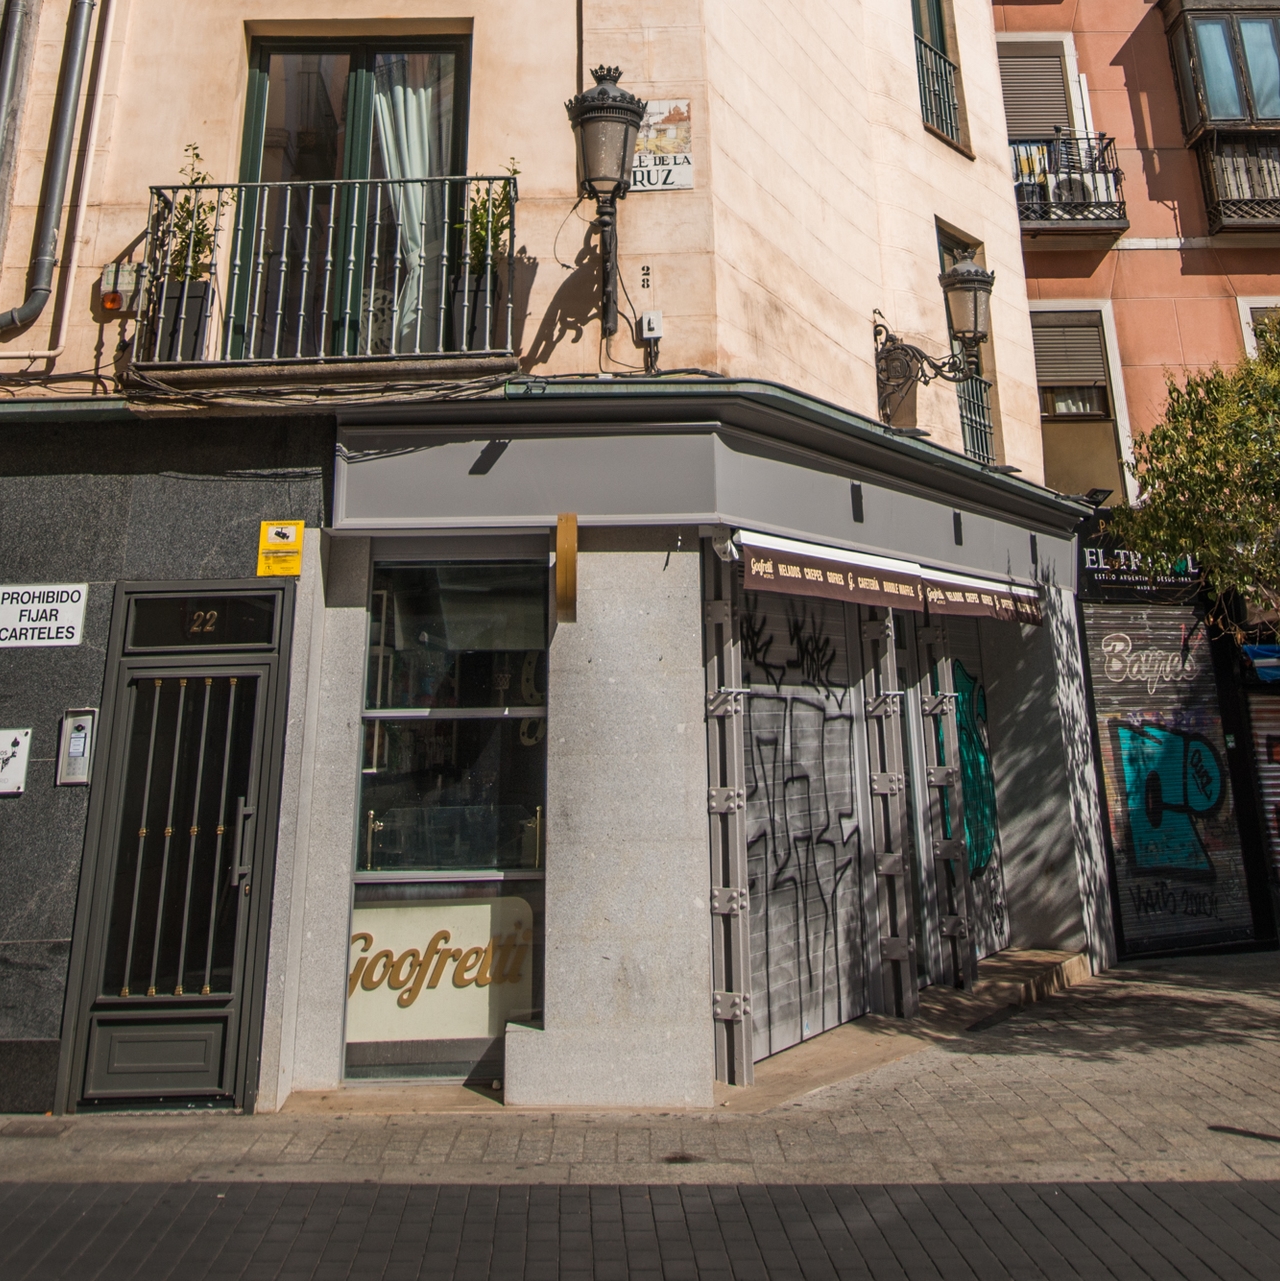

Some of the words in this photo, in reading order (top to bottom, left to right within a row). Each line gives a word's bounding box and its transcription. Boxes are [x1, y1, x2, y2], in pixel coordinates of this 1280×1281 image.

[653, 156, 670, 166] DE
[673, 155, 691, 165] LA
[632, 169, 675, 187] RUZ
[778, 563, 801, 579] HELADOS
[804, 567, 823, 582] CREPES
[0, 590, 81, 604] PROHIBIDO
[19, 608, 59, 622] FIJAR
[189, 610, 218, 633] 22
